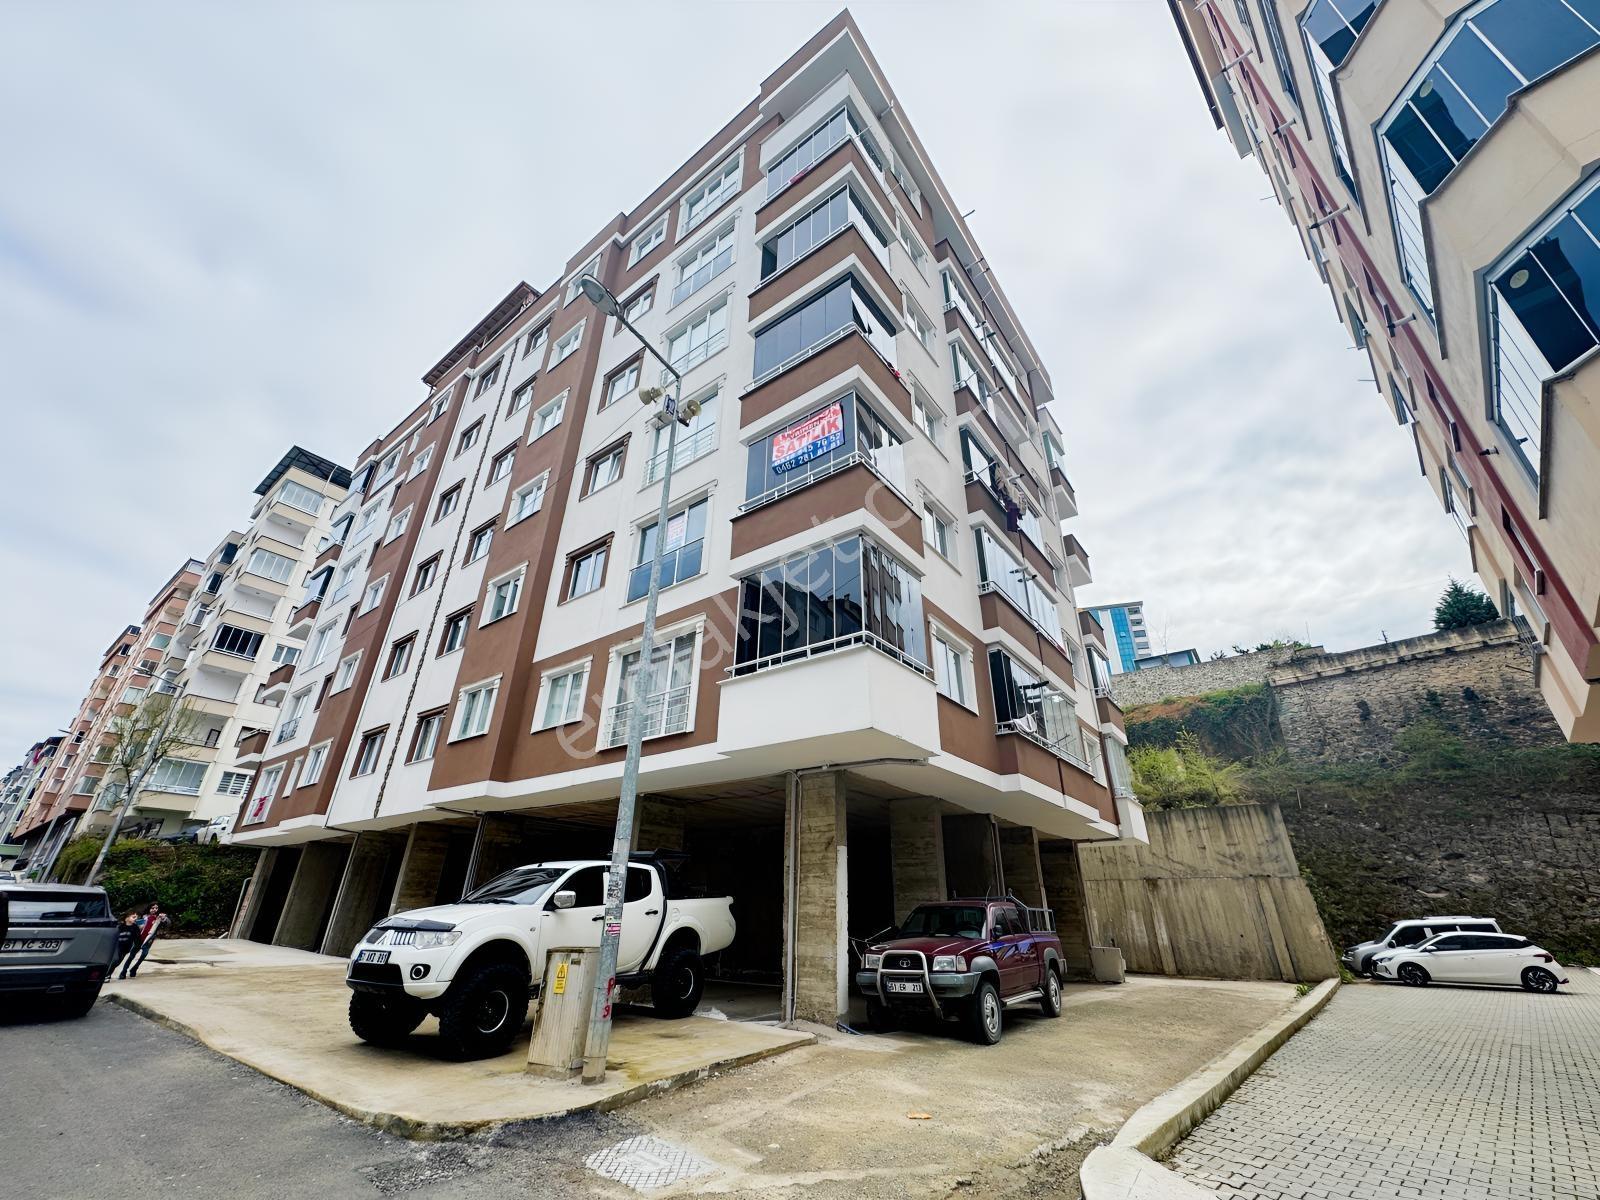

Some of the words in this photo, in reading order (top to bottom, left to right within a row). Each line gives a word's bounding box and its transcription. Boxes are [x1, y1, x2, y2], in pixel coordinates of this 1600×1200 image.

[775, 416, 840, 459] SATILIK
[775, 460, 797, 474] 0462
[20, 940, 34, 949] YC
[38, 940, 59, 949] 303
